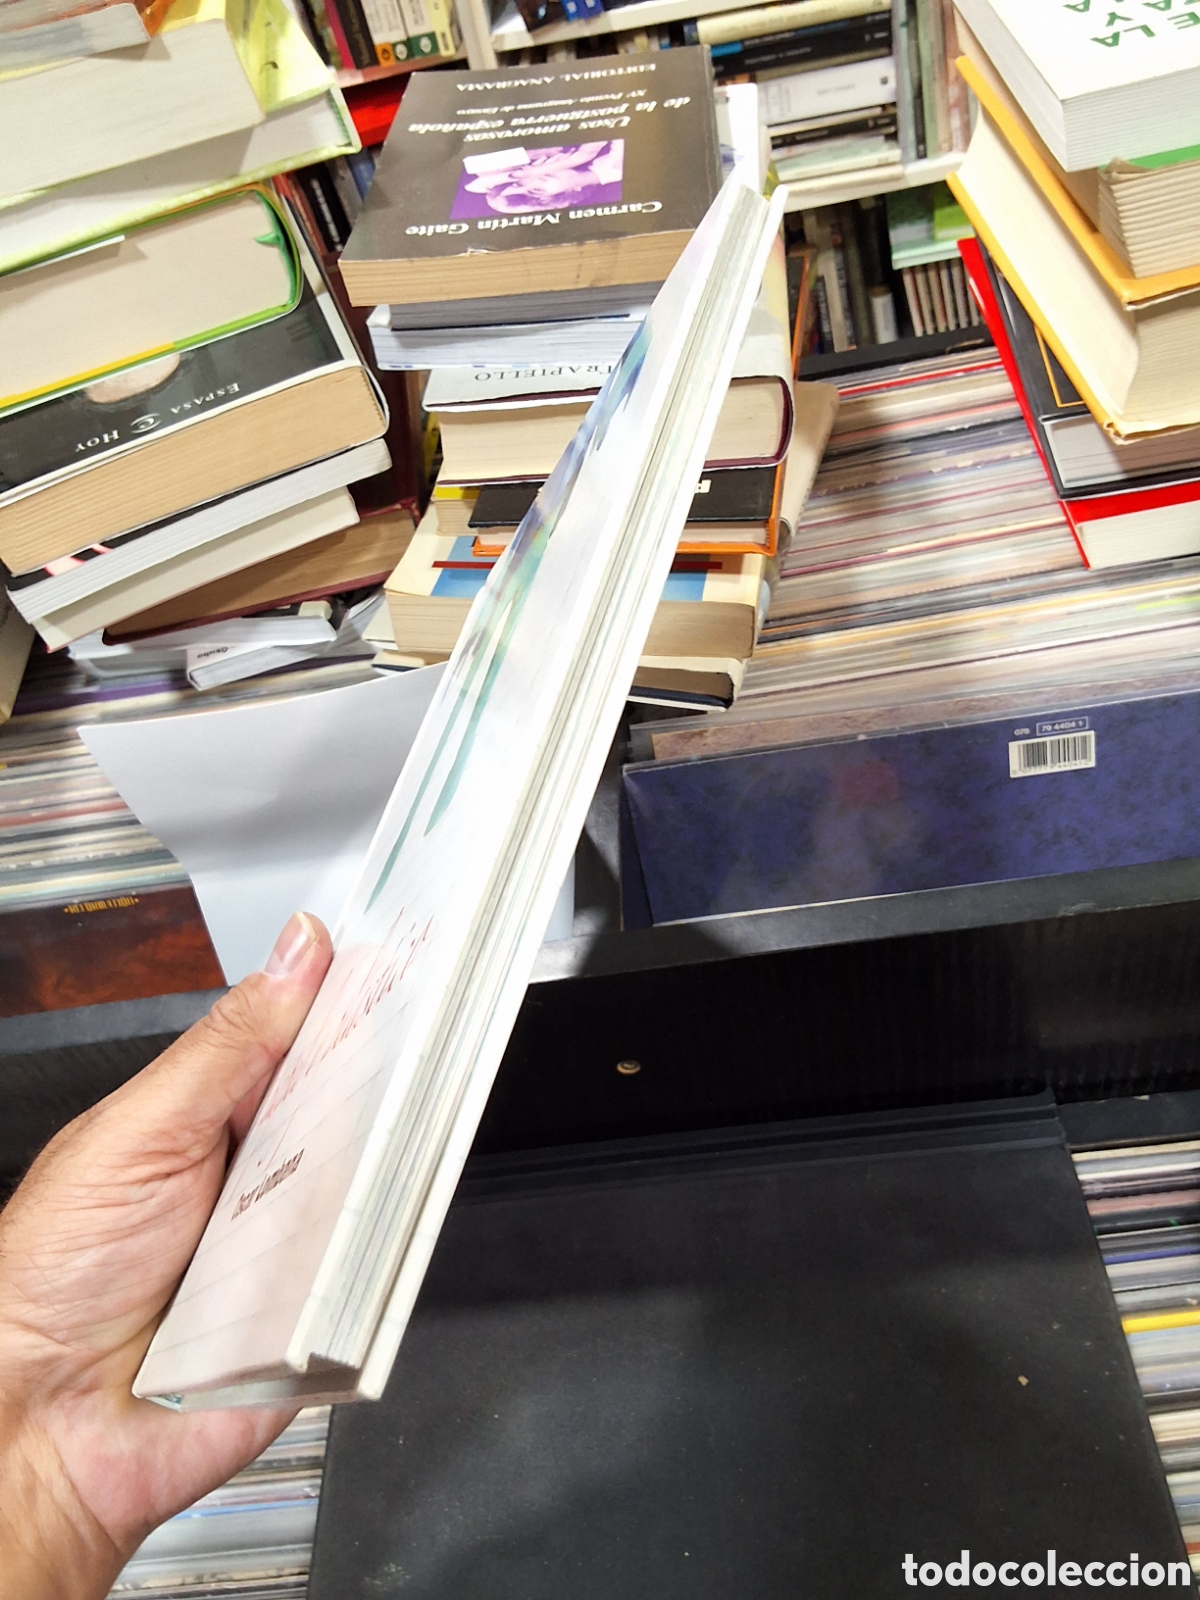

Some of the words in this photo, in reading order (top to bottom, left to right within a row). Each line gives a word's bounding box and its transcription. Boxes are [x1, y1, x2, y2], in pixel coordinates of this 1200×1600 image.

[1090, 24, 1156, 47] LA
[560, 63, 656, 82] EDITORIAL
[457, 76, 555, 91] ANAGRAMA
[635, 100, 657, 113] la
[664, 96, 691, 109] de
[510, 101, 630, 126] postguerra
[408, 117, 504, 134] española
[464, 122, 571, 142] amorosos
[578, 116, 631, 131] Usos
[569, 201, 663, 221] Carmen
[405, 223, 470, 236] Gaite
[477, 212, 561, 230] Martín
[170, 382, 241, 415] ESPASA
